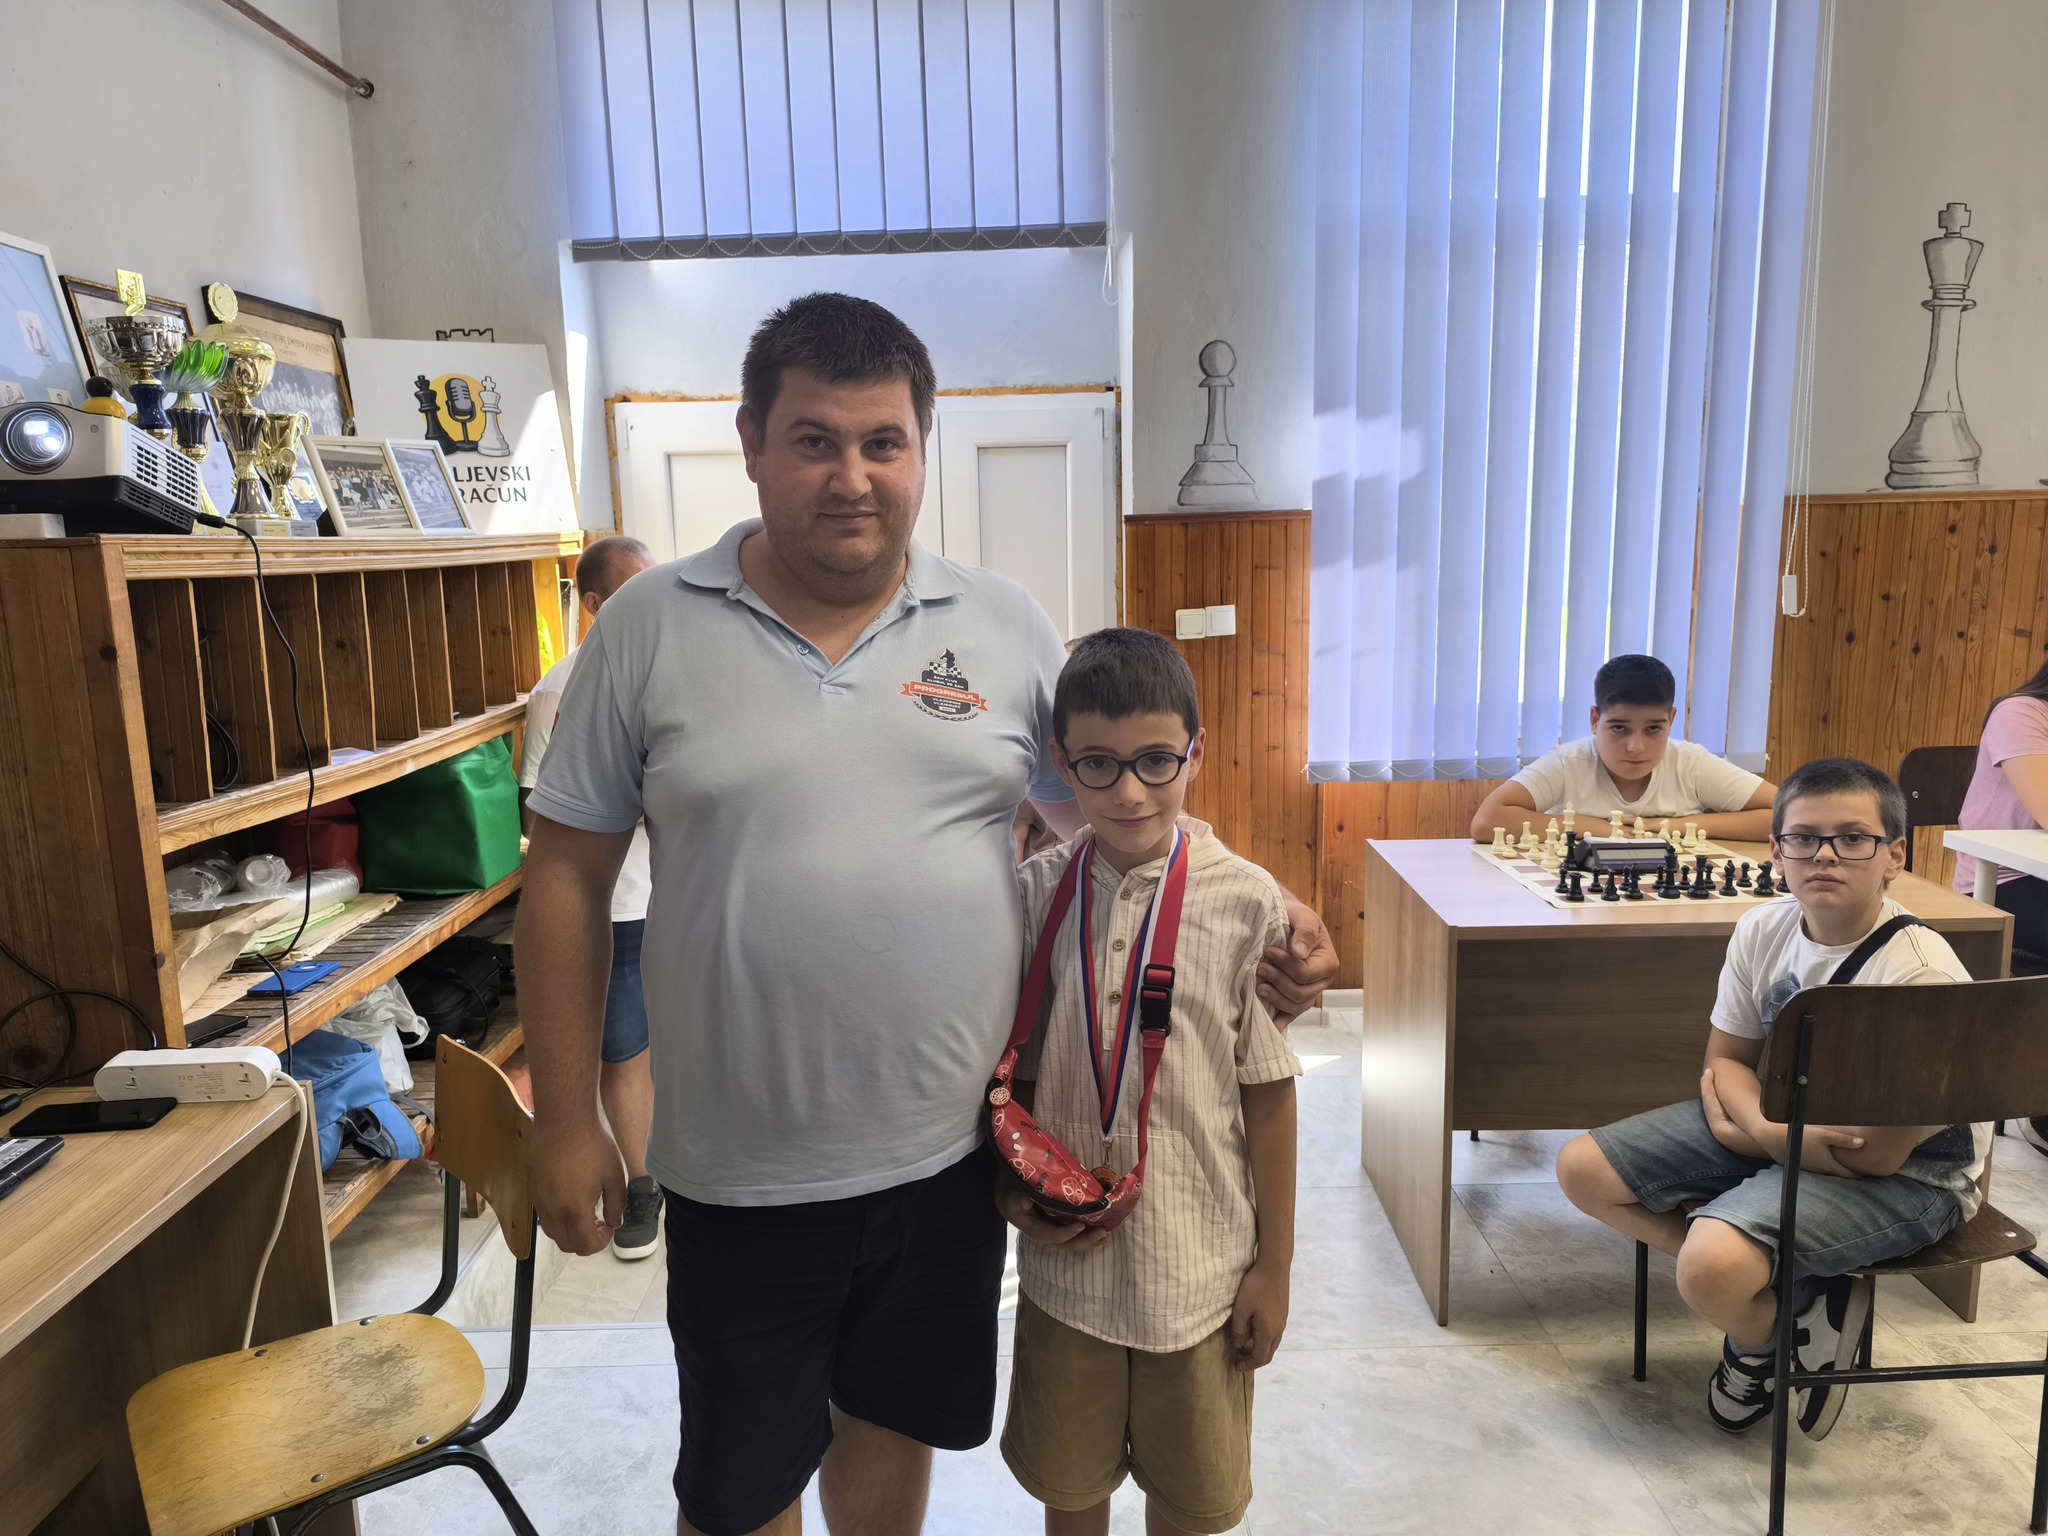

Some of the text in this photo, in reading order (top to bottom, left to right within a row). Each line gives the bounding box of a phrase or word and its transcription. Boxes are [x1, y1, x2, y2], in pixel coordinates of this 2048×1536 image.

[453, 466, 531, 482] LJEVSKI
[458, 484, 527, 503] RAČUN
[913, 684, 977, 701] PROGRESUL
